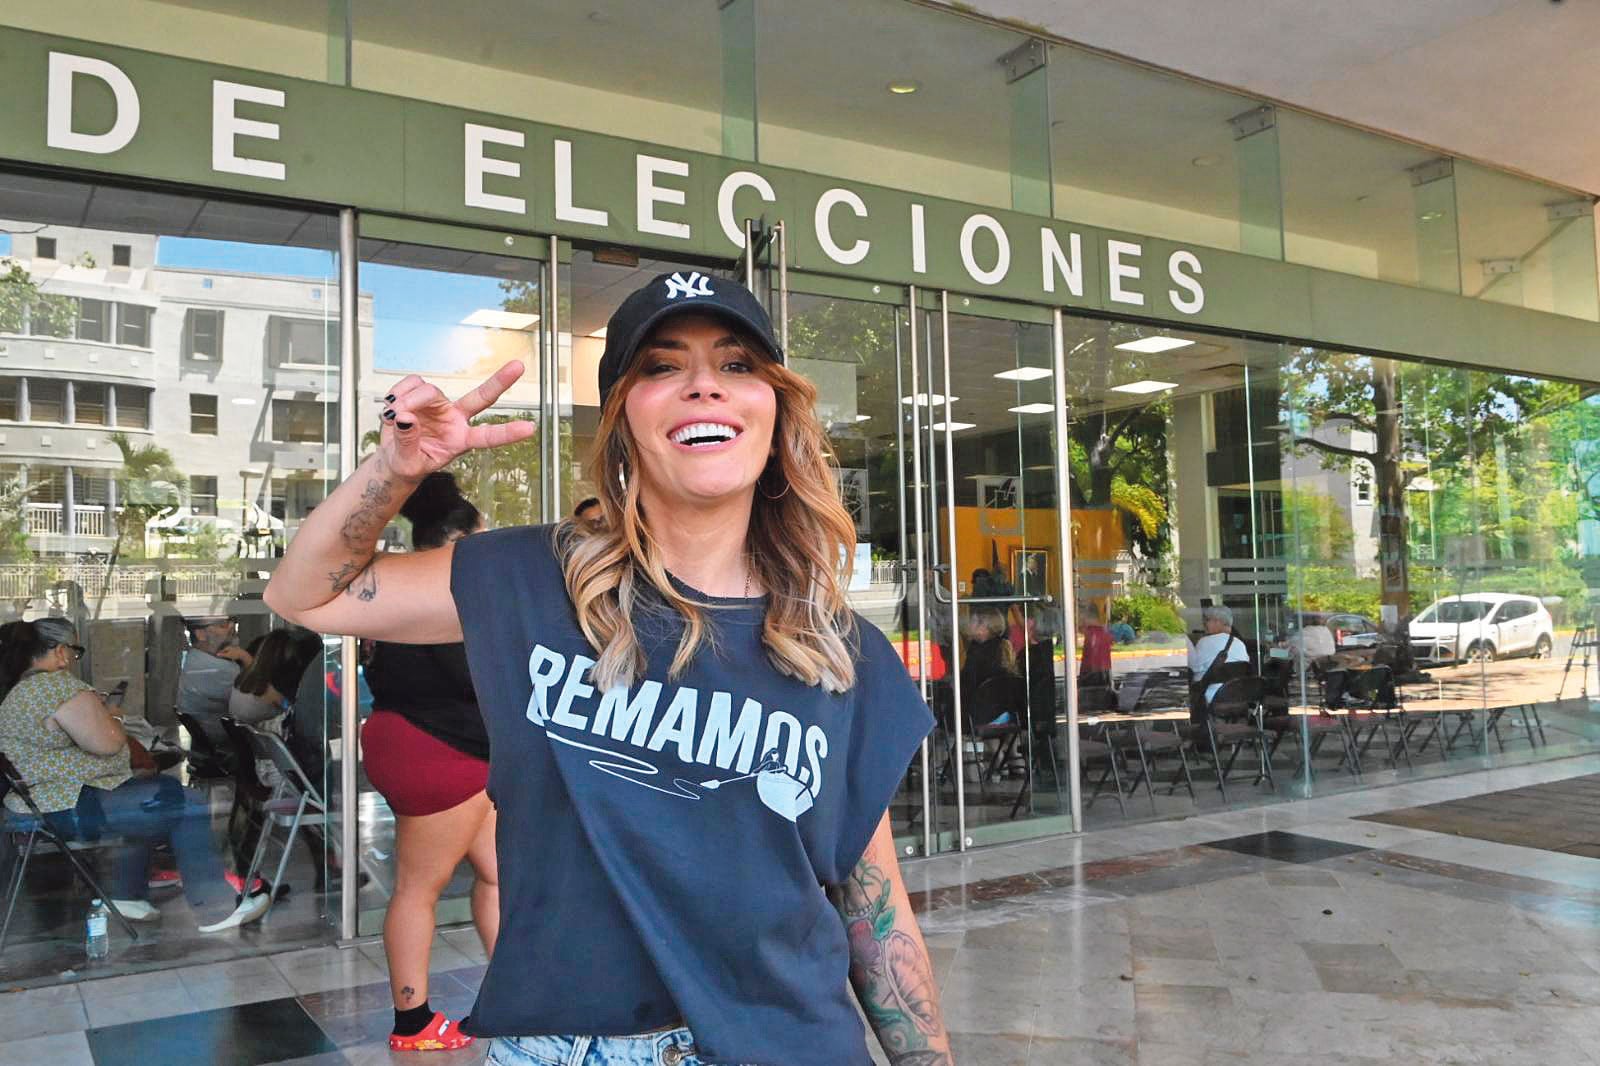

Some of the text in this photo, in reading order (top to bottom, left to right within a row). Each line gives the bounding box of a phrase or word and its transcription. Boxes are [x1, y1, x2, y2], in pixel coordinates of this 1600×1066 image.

[47, 51, 1206, 315] DE ELECCIONES
[665, 271, 715, 299] NY
[526, 643, 829, 799] REMAMOS
